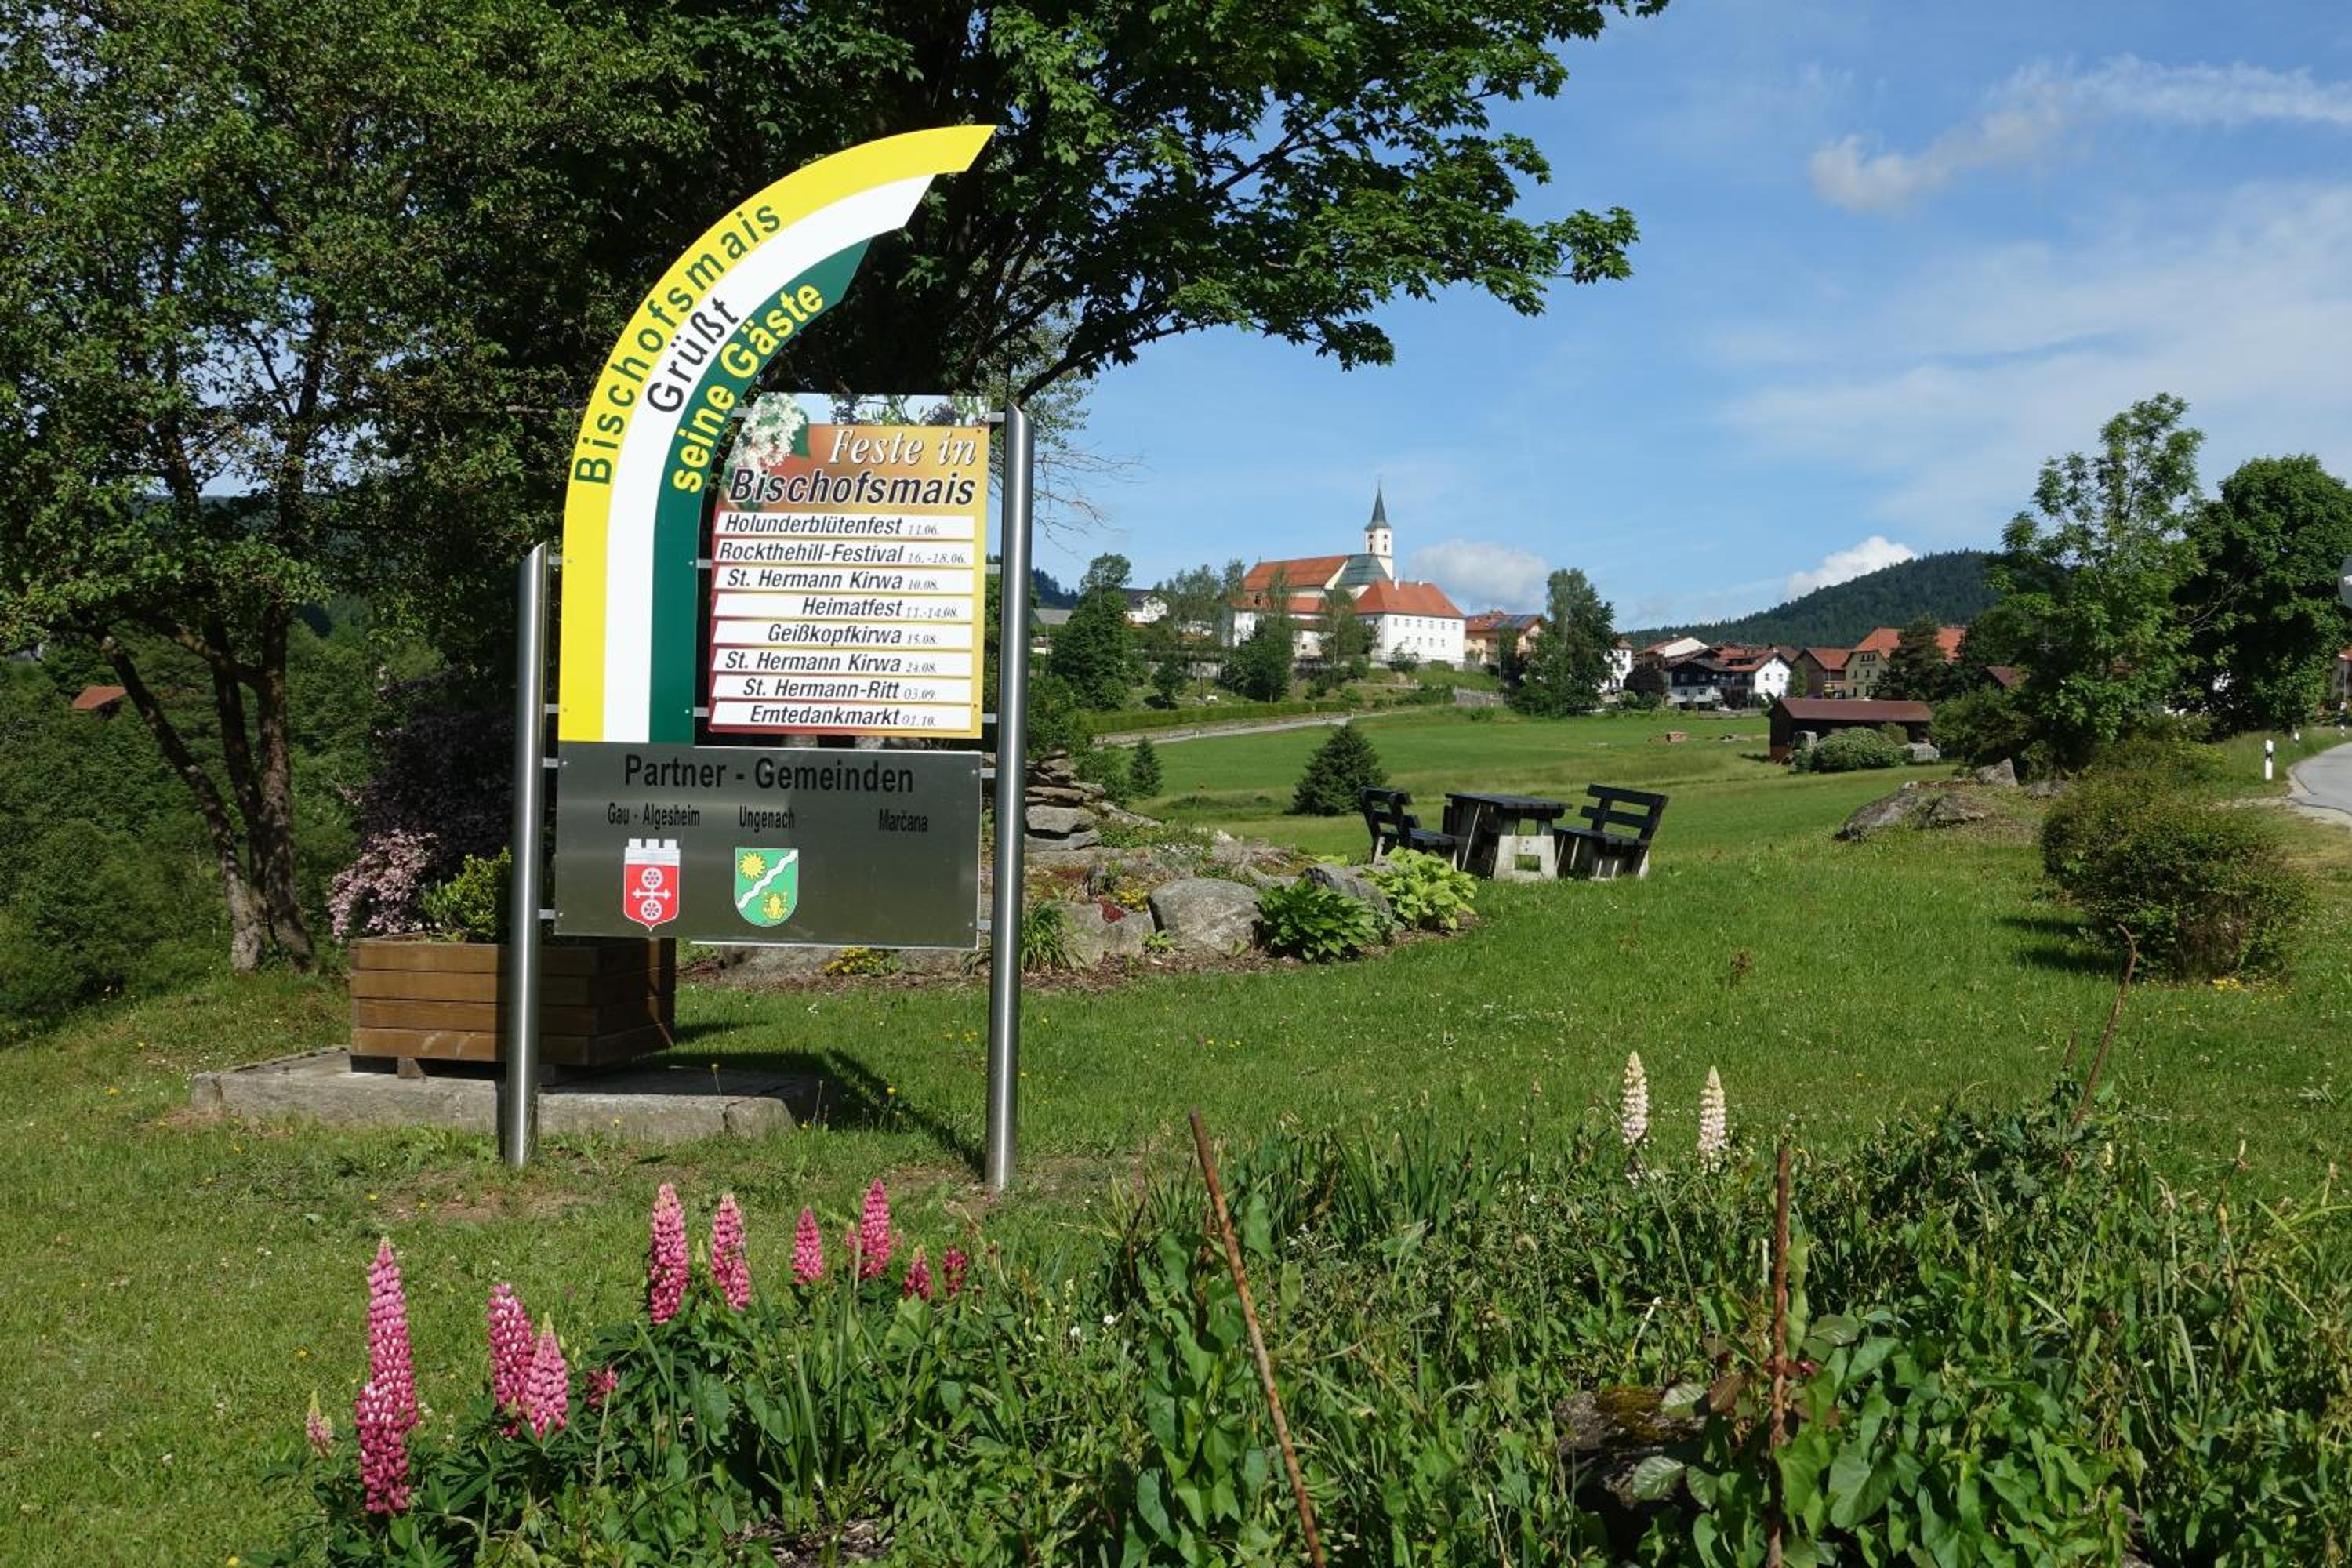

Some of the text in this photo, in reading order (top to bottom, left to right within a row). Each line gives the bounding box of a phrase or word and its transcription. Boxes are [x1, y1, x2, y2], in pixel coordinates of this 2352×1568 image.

[575, 205, 781, 485] Bischofsmais
[647, 296, 739, 413] Grüßt
[673, 284, 824, 493] seine Gäste
[828, 428, 977, 466] Feste in
[728, 468, 977, 506] Bischofsmais
[725, 514, 902, 535] Holunderblütenfest
[719, 541, 904, 563] Rockthehill-Festival
[727, 568, 750, 587] St.
[758, 569, 842, 589] Hermann
[849, 571, 902, 590] Kirwa
[802, 597, 902, 618] Heimatfest
[768, 624, 902, 646] Geißkopfkirwa
[725, 650, 750, 669] St.
[757, 652, 841, 671] Hermann
[848, 653, 902, 673] Kirwa
[742, 677, 766, 697] St.
[774, 679, 901, 699] Hermann-Ritt
[750, 705, 901, 726] Erntedankmarkt
[625, 754, 727, 789] Partner
[754, 757, 914, 793] Gemeinden
[608, 802, 629, 825] Gau
[642, 802, 701, 830] Algesheim
[739, 805, 795, 832] Ungenach
